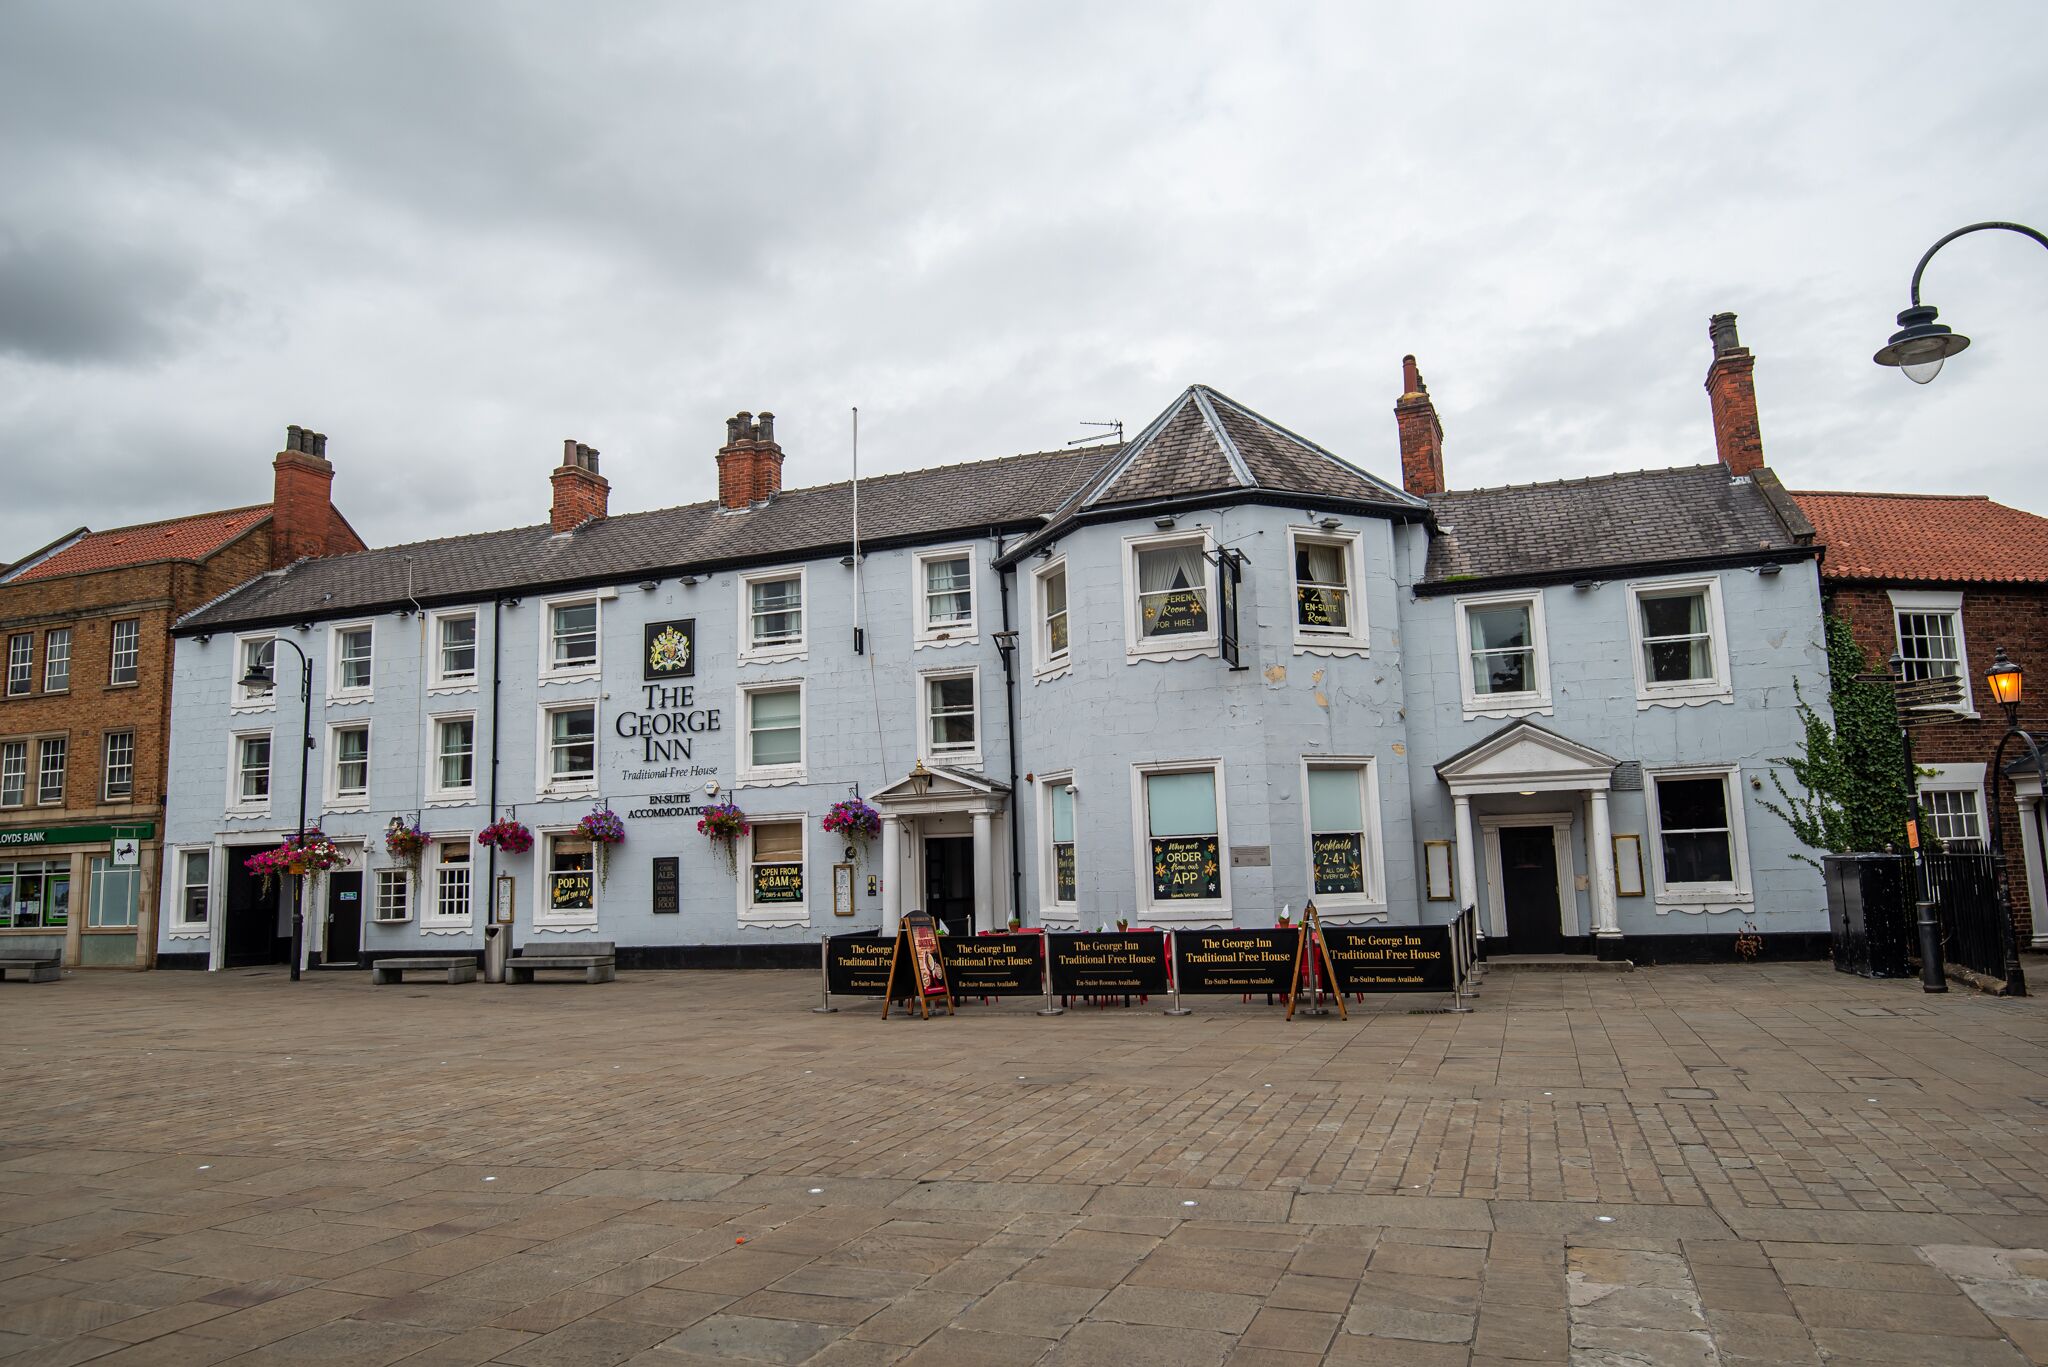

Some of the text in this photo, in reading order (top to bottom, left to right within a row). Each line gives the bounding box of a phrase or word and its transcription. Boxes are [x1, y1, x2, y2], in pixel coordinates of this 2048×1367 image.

[1162, 605, 1187, 617] Room
[1156, 619, 1195, 629] FOR HIRE!
[641, 684, 694, 710] THE
[615, 709, 721, 738] GEORGE
[643, 736, 692, 762] INN
[622, 765, 717, 780] Traditional Free House
[649, 794, 691, 805] EN-SUITE
[0, 832, 45, 844] OYDS BANK
[1168, 842, 1199, 852] Why not
[1313, 839, 1352, 853] Cocktails
[1166, 852, 1202, 862] ORDER
[1322, 852, 1346, 865] 2-4-1
[761, 867, 798, 876] OPEN FROM
[1170, 863, 1186, 872] from
[557, 877, 589, 889] POP IN
[769, 876, 789, 887] 8AM
[1173, 872, 1198, 884] APP
[1074, 941, 1139, 952] The George Inn
[1202, 938, 1272, 950] The George Inn
[1347, 936, 1421, 947] The George Inn
[851, 945, 892, 955] The George
[957, 944, 1016, 955] The George Inn
[1330, 949, 1441, 960] Traditional Free House
[838, 957, 878, 967] Traditional
[944, 956, 1033, 967] Traditional Free House
[1059, 953, 1156, 965] Traditional Free House
[1186, 951, 1290, 963] Traditional Free House
